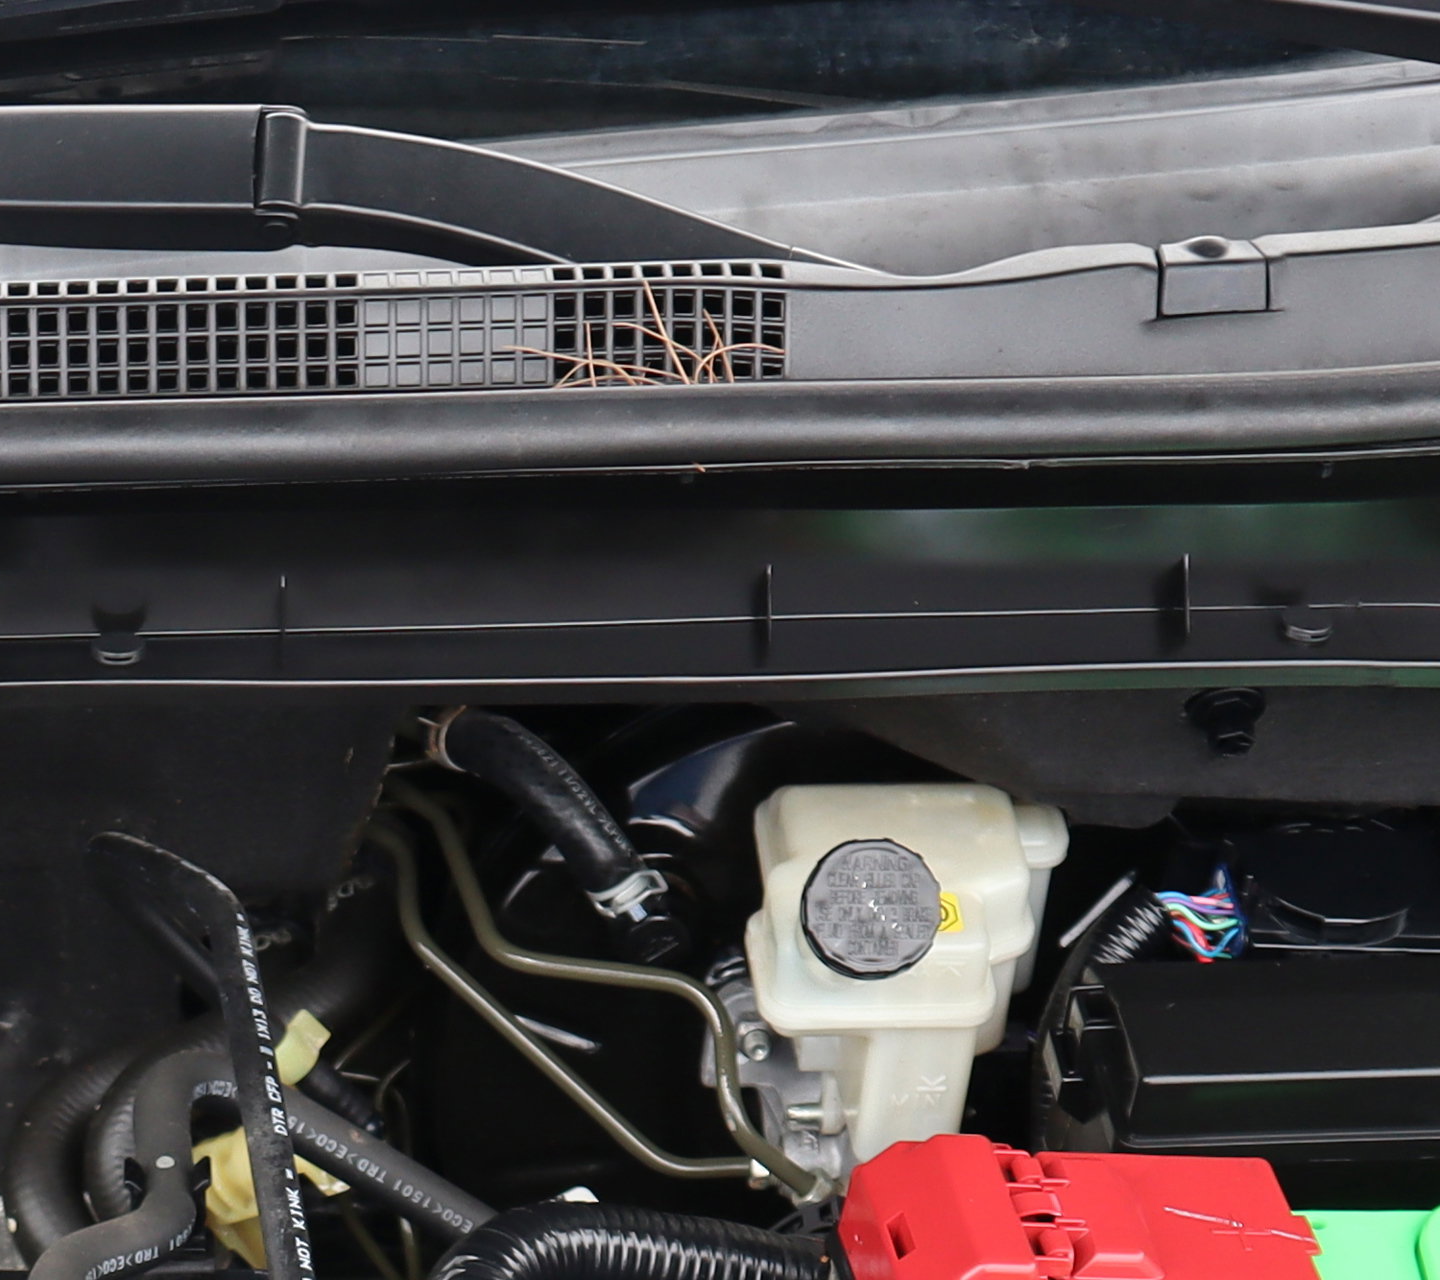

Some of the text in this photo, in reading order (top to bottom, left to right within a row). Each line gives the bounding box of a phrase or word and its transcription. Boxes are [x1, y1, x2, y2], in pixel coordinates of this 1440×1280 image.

[842, 855, 911, 871] WARNING
[236, 925, 254, 957] KINK
[242, 959, 259, 984] NOT
[247, 986, 264, 1005] DO
[265, 1075, 283, 1103] CFP
[271, 1107, 288, 1136] DTR
[285, 1187, 306, 1231] KINK
[293, 1237, 313, 1271] NOT
